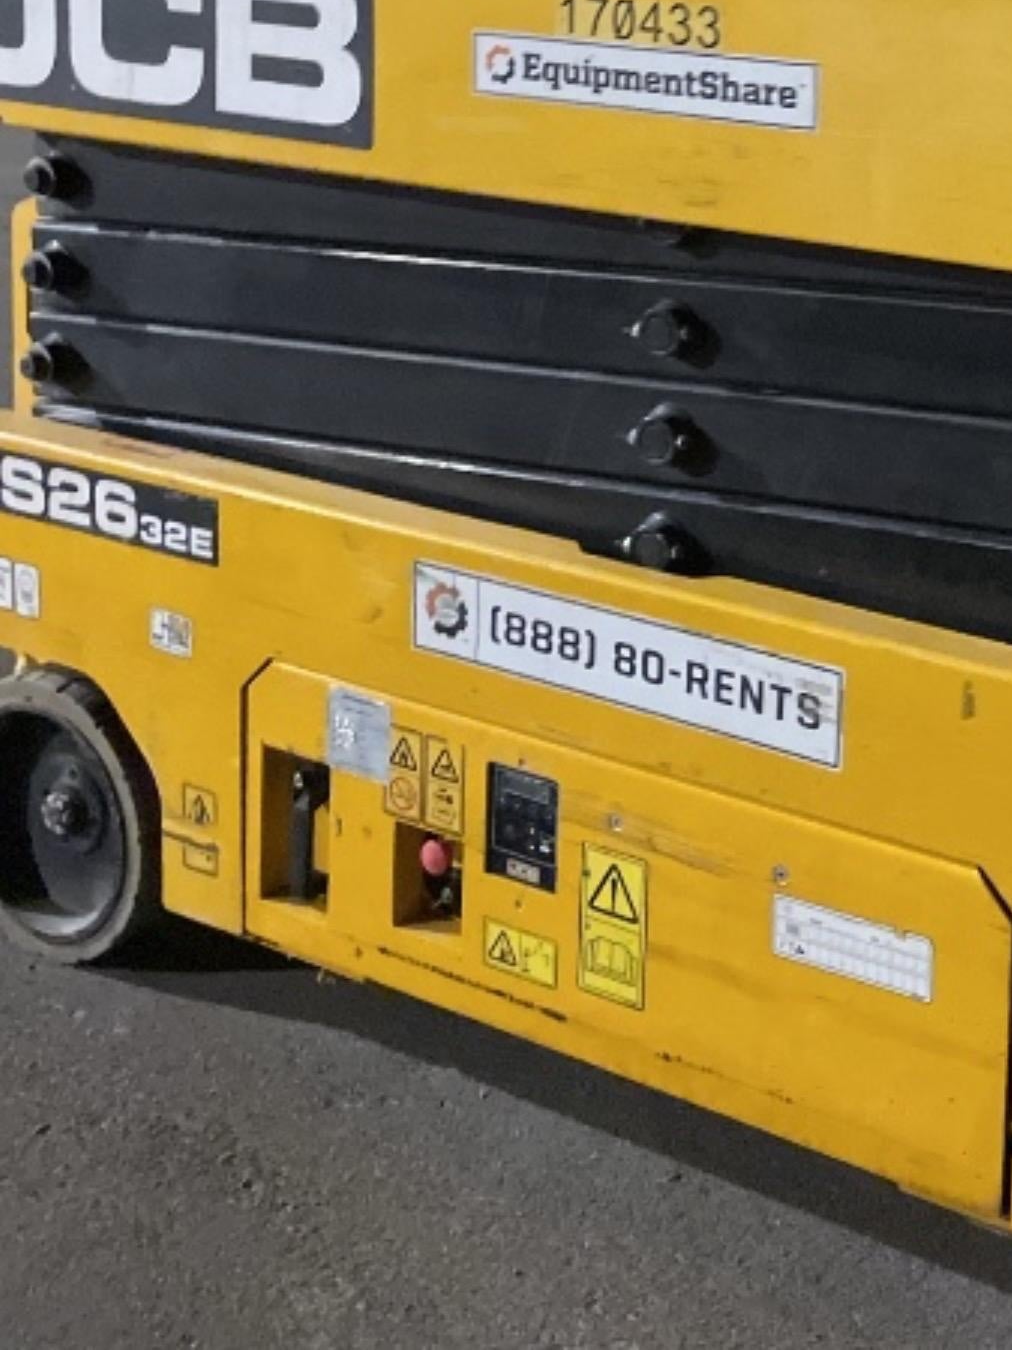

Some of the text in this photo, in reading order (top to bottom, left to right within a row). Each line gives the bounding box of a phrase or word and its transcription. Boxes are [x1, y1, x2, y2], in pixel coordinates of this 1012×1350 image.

[521, 52, 799, 110] EquipmentShare
[491, 605, 821, 730] (888) 80-RENTS
